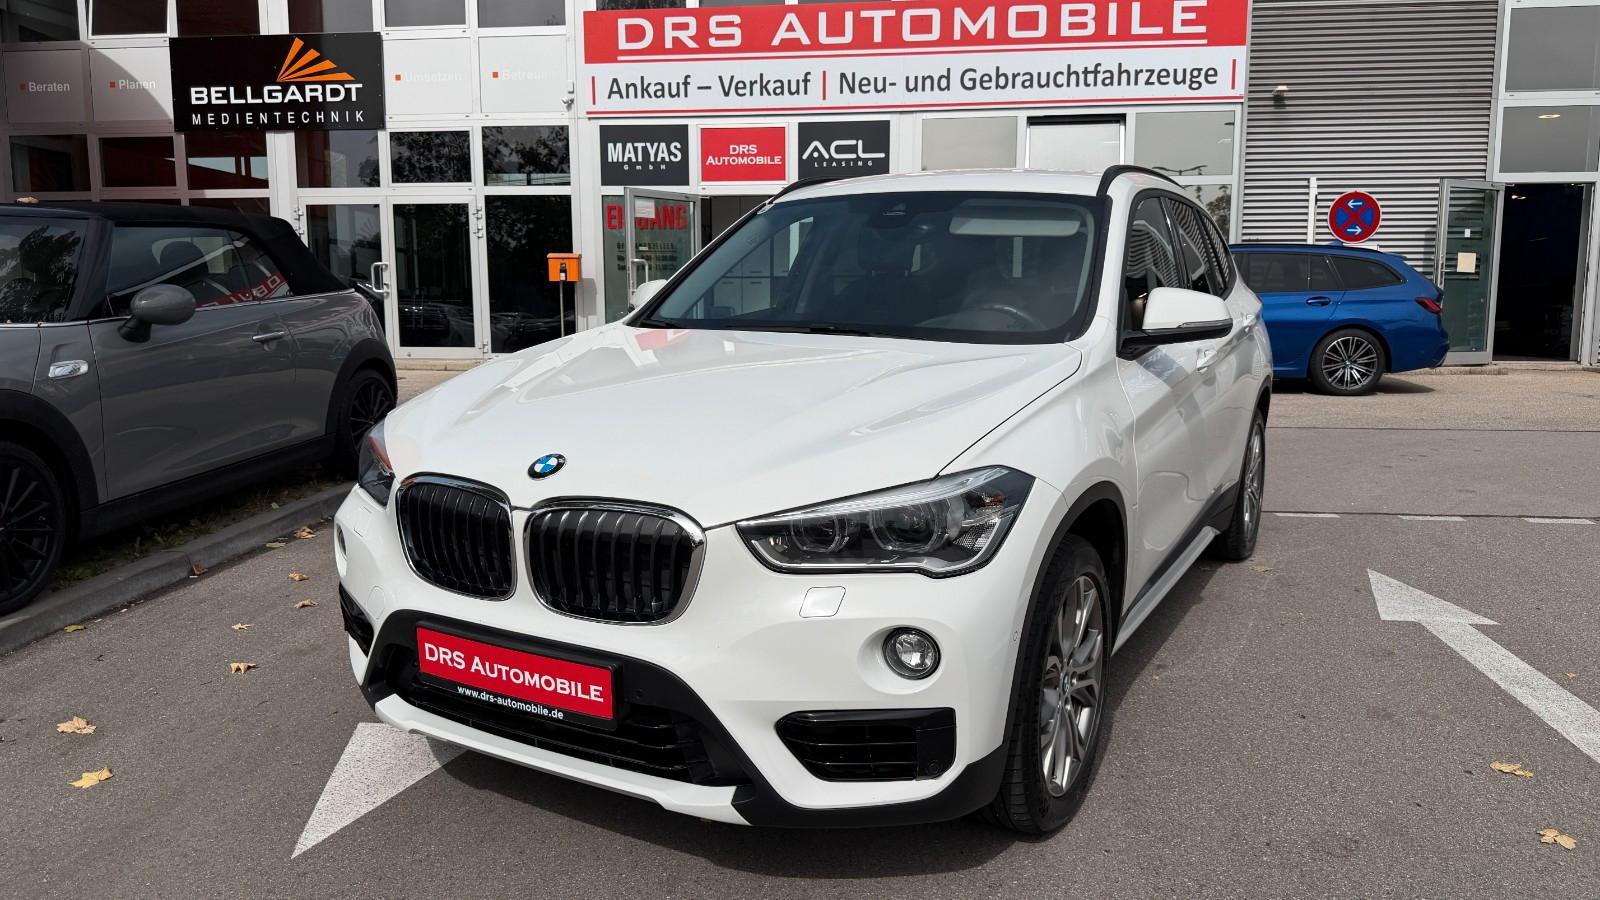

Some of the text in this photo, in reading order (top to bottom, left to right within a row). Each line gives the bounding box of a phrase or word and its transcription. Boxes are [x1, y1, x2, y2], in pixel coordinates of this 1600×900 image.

[617, 0, 1208, 50] DRS AUTOMOBILE
[28, 81, 71, 92] Beraten
[119, 79, 156, 90] Planen
[607, 74, 692, 100] Ankauf
[718, 71, 811, 97] Verkauf
[839, 72, 897, 94] Neu-
[905, 67, 951, 92] und
[959, 62, 1218, 91] Gebrauchtfahrzeuge
[190, 83, 363, 105] BELLGARDT
[191, 110, 364, 126] MEDIENTECHNIK
[607, 141, 682, 163] MATYAS
[705, 154, 782, 166] AUTOMOBILE
[729, 144, 758, 155] DRS
[802, 139, 885, 160] ACL
[814, 160, 873, 168] LEASING
[607, 205, 687, 230] EIANG
[424, 642, 604, 702] DRS AUTOMOBILE
[457, 685, 564, 719] www.drs-automobile.de
